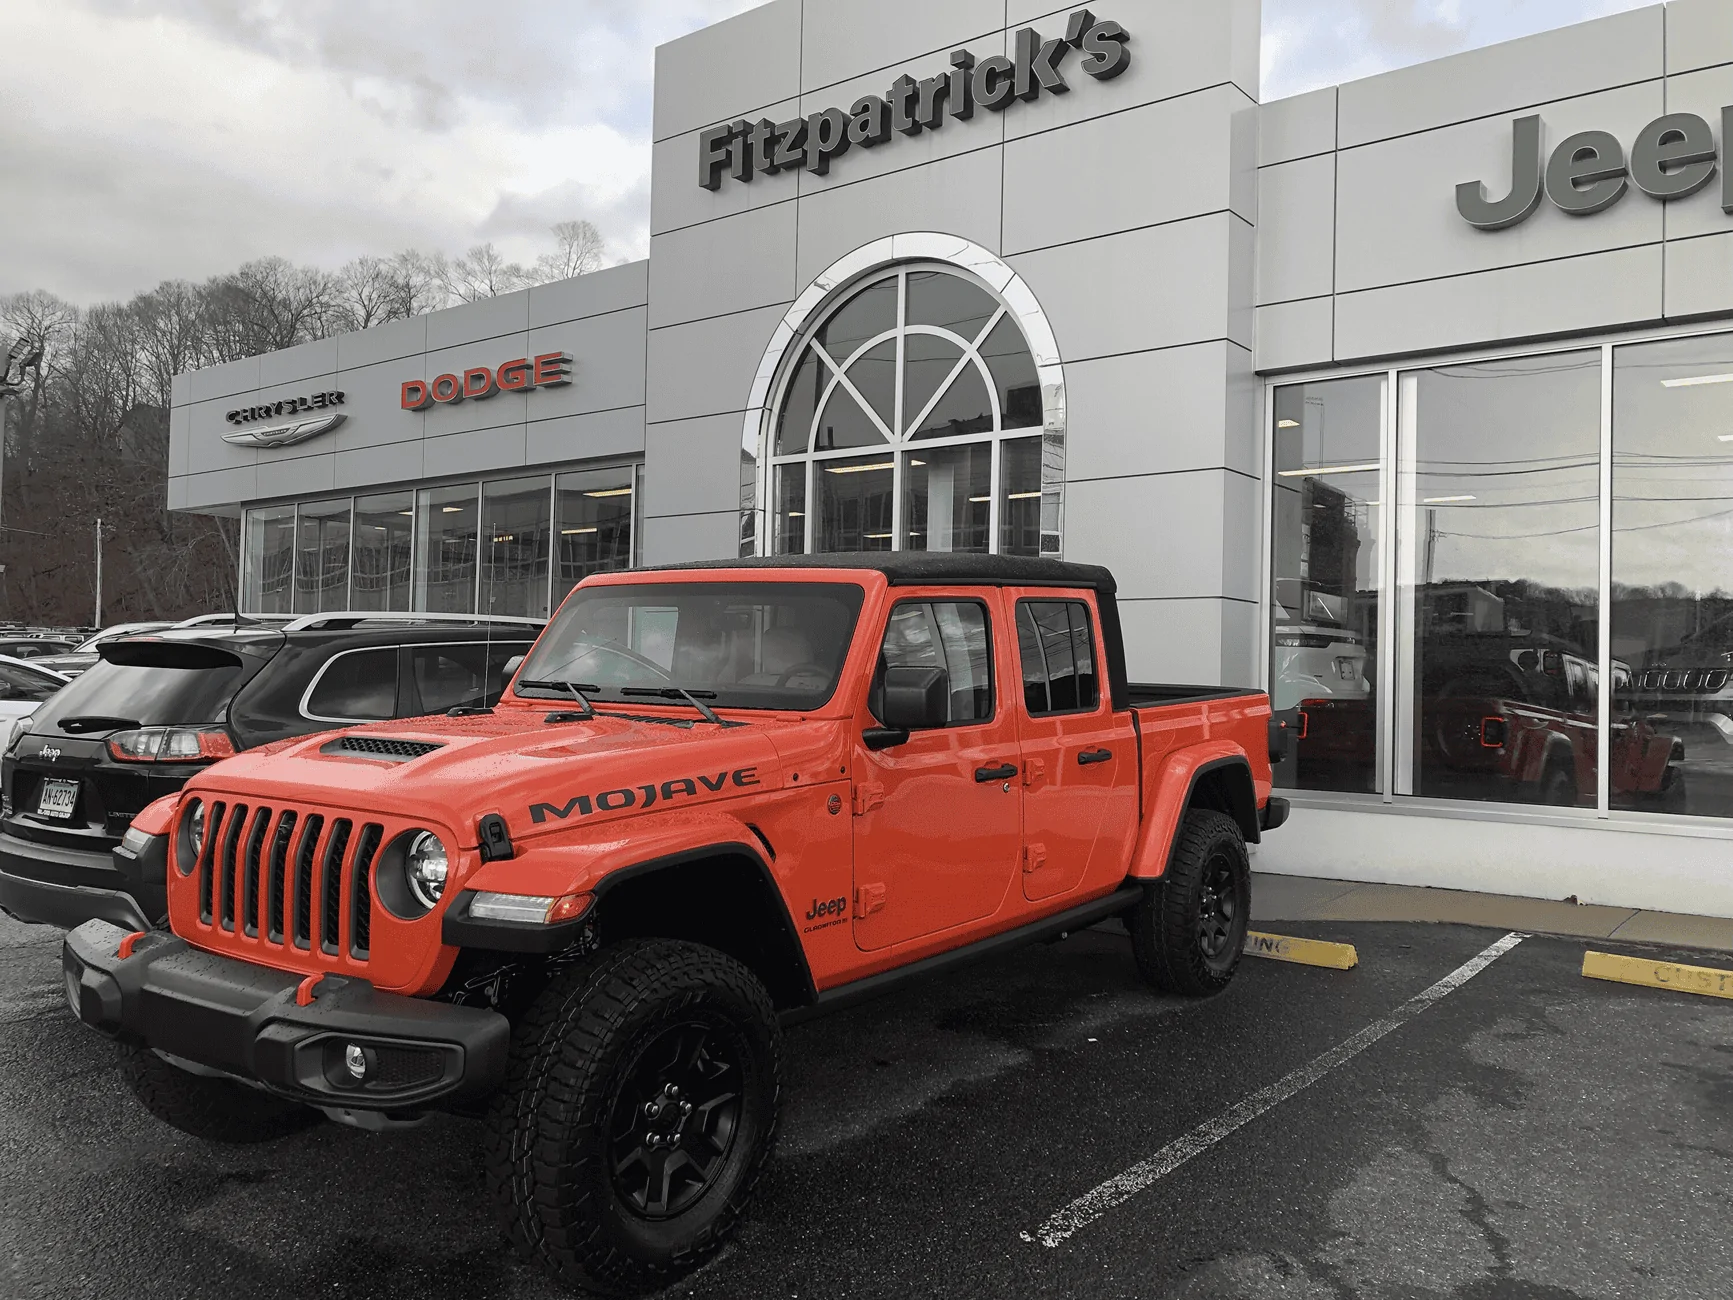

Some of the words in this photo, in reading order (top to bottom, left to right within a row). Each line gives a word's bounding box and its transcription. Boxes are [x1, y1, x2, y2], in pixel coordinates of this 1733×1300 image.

[699, 9, 1131, 191] Fitzpatrick's
[401, 351, 574, 412] DODGE
[225, 390, 345, 425] CHRYSLER
[528, 767, 761, 824] MOJAVE
[108, 811, 138, 819] LIMITE
[805, 896, 847, 920] Jeep
[803, 919, 842, 934] GLADIATOR
[1247, 935, 1291, 955] ING
[1654, 965, 1733, 991] CUST
